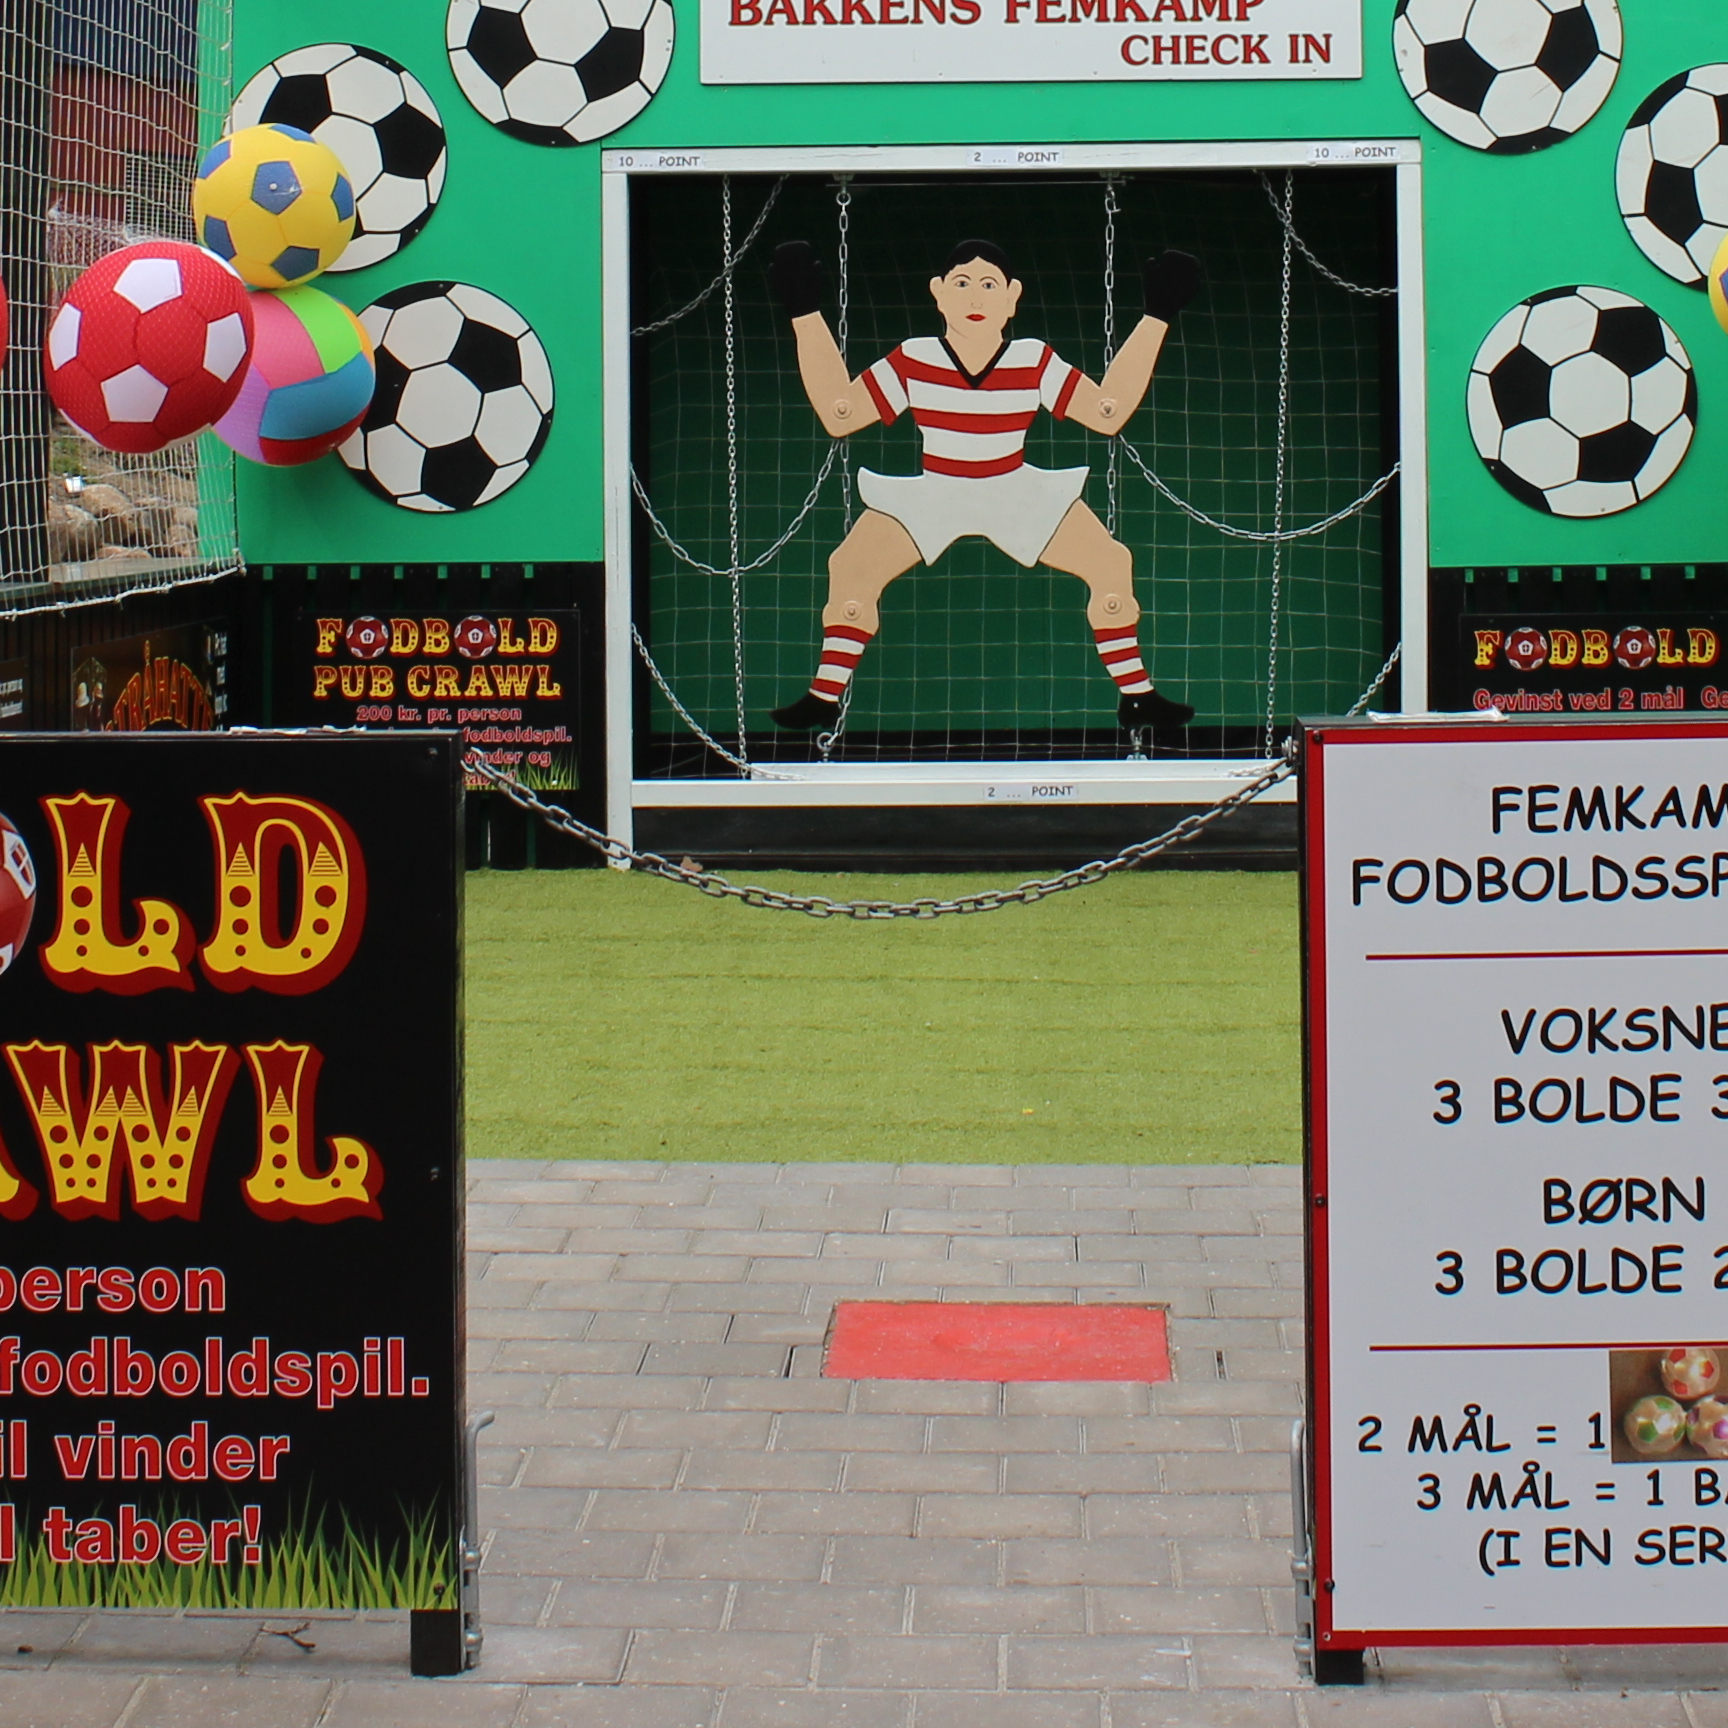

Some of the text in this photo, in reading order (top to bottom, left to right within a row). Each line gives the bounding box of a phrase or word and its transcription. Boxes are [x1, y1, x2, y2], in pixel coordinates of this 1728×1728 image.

[1120, 33, 1333, 66] CHECK IN
[618, 156, 634, 168] 10
[658, 155, 701, 167] POINT
[973, 152, 983, 163] 2
[1017, 151, 1060, 164] POINT
[1314, 147, 1330, 159] 10
[1354, 145, 1397, 158] POINT
[312, 663, 563, 700] PUB CRAWL
[1473, 686, 1684, 712] Gevinst ved 2 mål
[356, 705, 523, 724] 200 kr. pr. person
[463, 726, 573, 744] fodboldspil.
[528, 752, 552, 767] og
[987, 786, 996, 797] 2
[1031, 785, 1074, 797] POINT
[1433, 1081, 1464, 1125] 3
[1495, 1075, 1683, 1125] BOLDE
[1543, 1176, 1706, 1226] BØRN
[1435, 1251, 1465, 1296] 3
[1497, 1245, 1684, 1295] BOLDE
[1358, 1416, 1383, 1454] 2
[1408, 1404, 1511, 1454] MÅL
[1537, 1426, 1558, 1443] =
[1587, 1412, 1607, 1451] 1
[52, 1418, 292, 1481] vinder
[1417, 1475, 1442, 1511] 3
[1466, 1461, 1570, 1511] MÅL
[1595, 1483, 1616, 1500] =
[1646, 1471, 1665, 1508] 1
[41, 1503, 265, 1566] taber!
[1479, 1529, 1522, 1578] (I
[1545, 1528, 1612, 1568] EN
